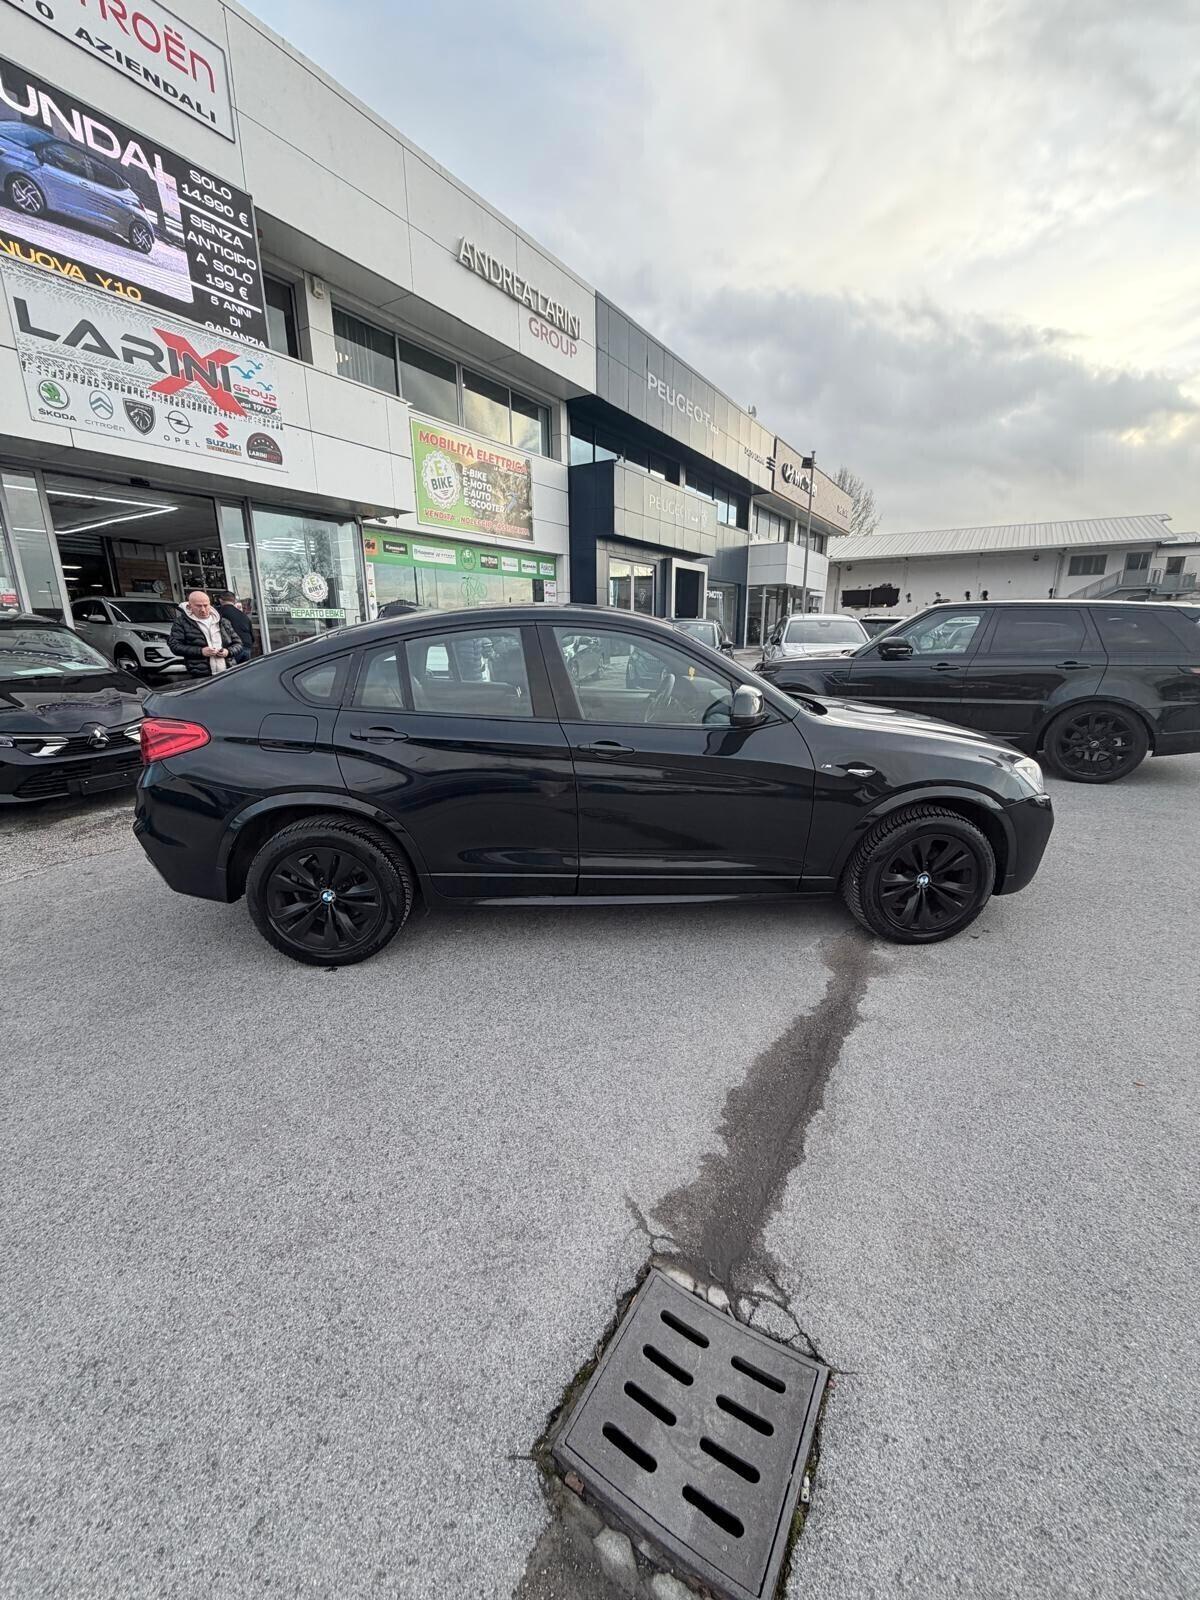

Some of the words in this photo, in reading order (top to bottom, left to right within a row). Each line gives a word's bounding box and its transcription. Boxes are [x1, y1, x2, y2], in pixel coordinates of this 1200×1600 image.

[80, 0, 215, 93] ROËn
[75, 27, 216, 124] AZIENDALI
[189, 169, 232, 200] SOLO
[181, 183, 234, 218] 14.990
[238, 212, 249, 227] €
[189, 214, 244, 250] SENZA
[186, 230, 257, 271] ANTICIPO
[196, 252, 208, 266] A
[212, 259, 253, 285] SOLO
[455, 236, 534, 313] ANDREA
[95, 273, 142, 301] Y10
[205, 273, 234, 293] 199
[238, 286, 249, 300] €
[210, 295, 219, 305] 5
[223, 301, 252, 319] ANNI
[204, 321, 266, 349] GARANZIA
[229, 315, 241, 328] DI
[13, 296, 232, 393] LARINI
[528, 316, 577, 358] GROUP
[233, 383, 277, 402] GROUP
[647, 371, 711, 427] PEUGEOT
[38, 408, 77, 422] ŠKODA
[252, 403, 272, 414] 1970
[205, 437, 242, 451] SUZUKI
[419, 430, 474, 458] MOBILITÀ
[430, 475, 454, 491] BIKE
[462, 466, 488, 482] E-BIKE
[462, 477, 493, 492] E-MOTO
[463, 487, 491, 501] E-AUTO
[464, 497, 506, 513] E-SCOOTER
[291, 609, 324, 617] REPARTO
